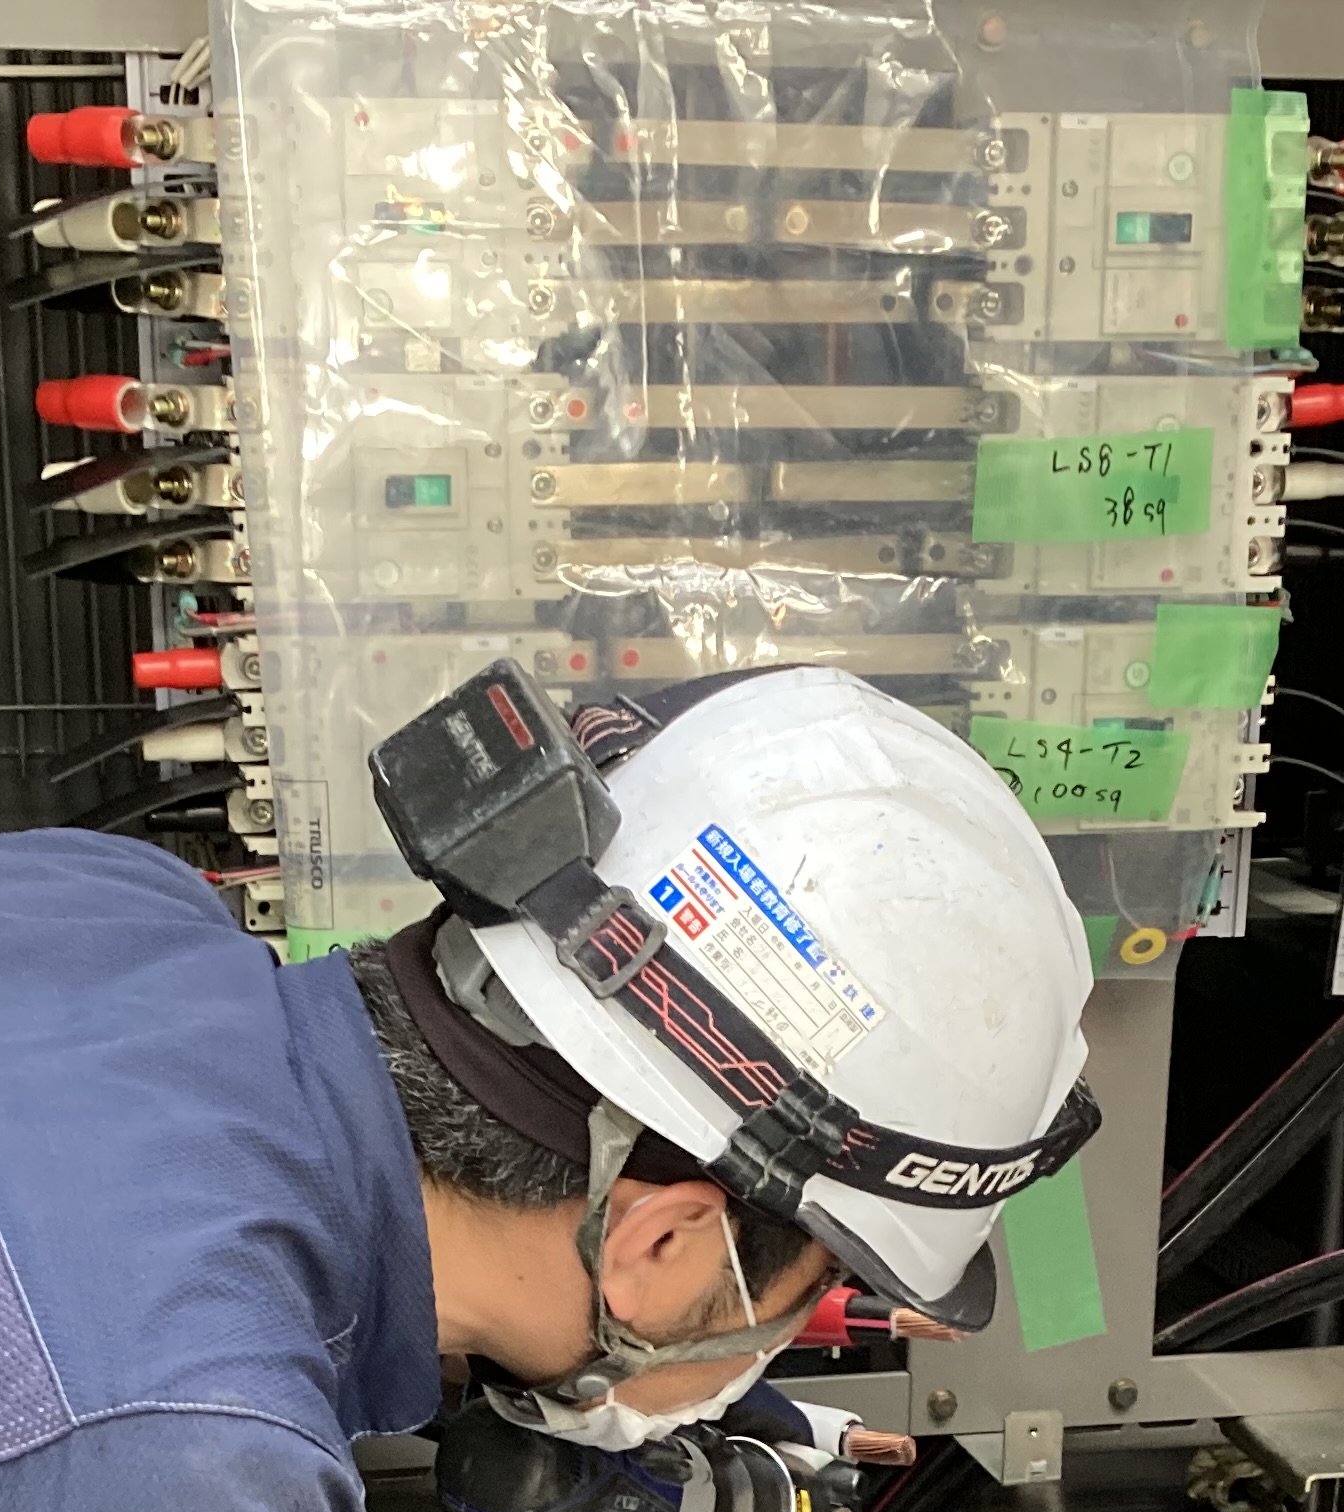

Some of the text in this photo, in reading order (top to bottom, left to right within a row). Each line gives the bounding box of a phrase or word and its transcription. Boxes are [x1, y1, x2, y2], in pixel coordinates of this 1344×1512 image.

[308, 818, 324, 891] TRUSCO
[656, 884, 674, 902] 1
[729, 916, 757, 945] 会社名
[828, 1001, 837, 1010] 日
